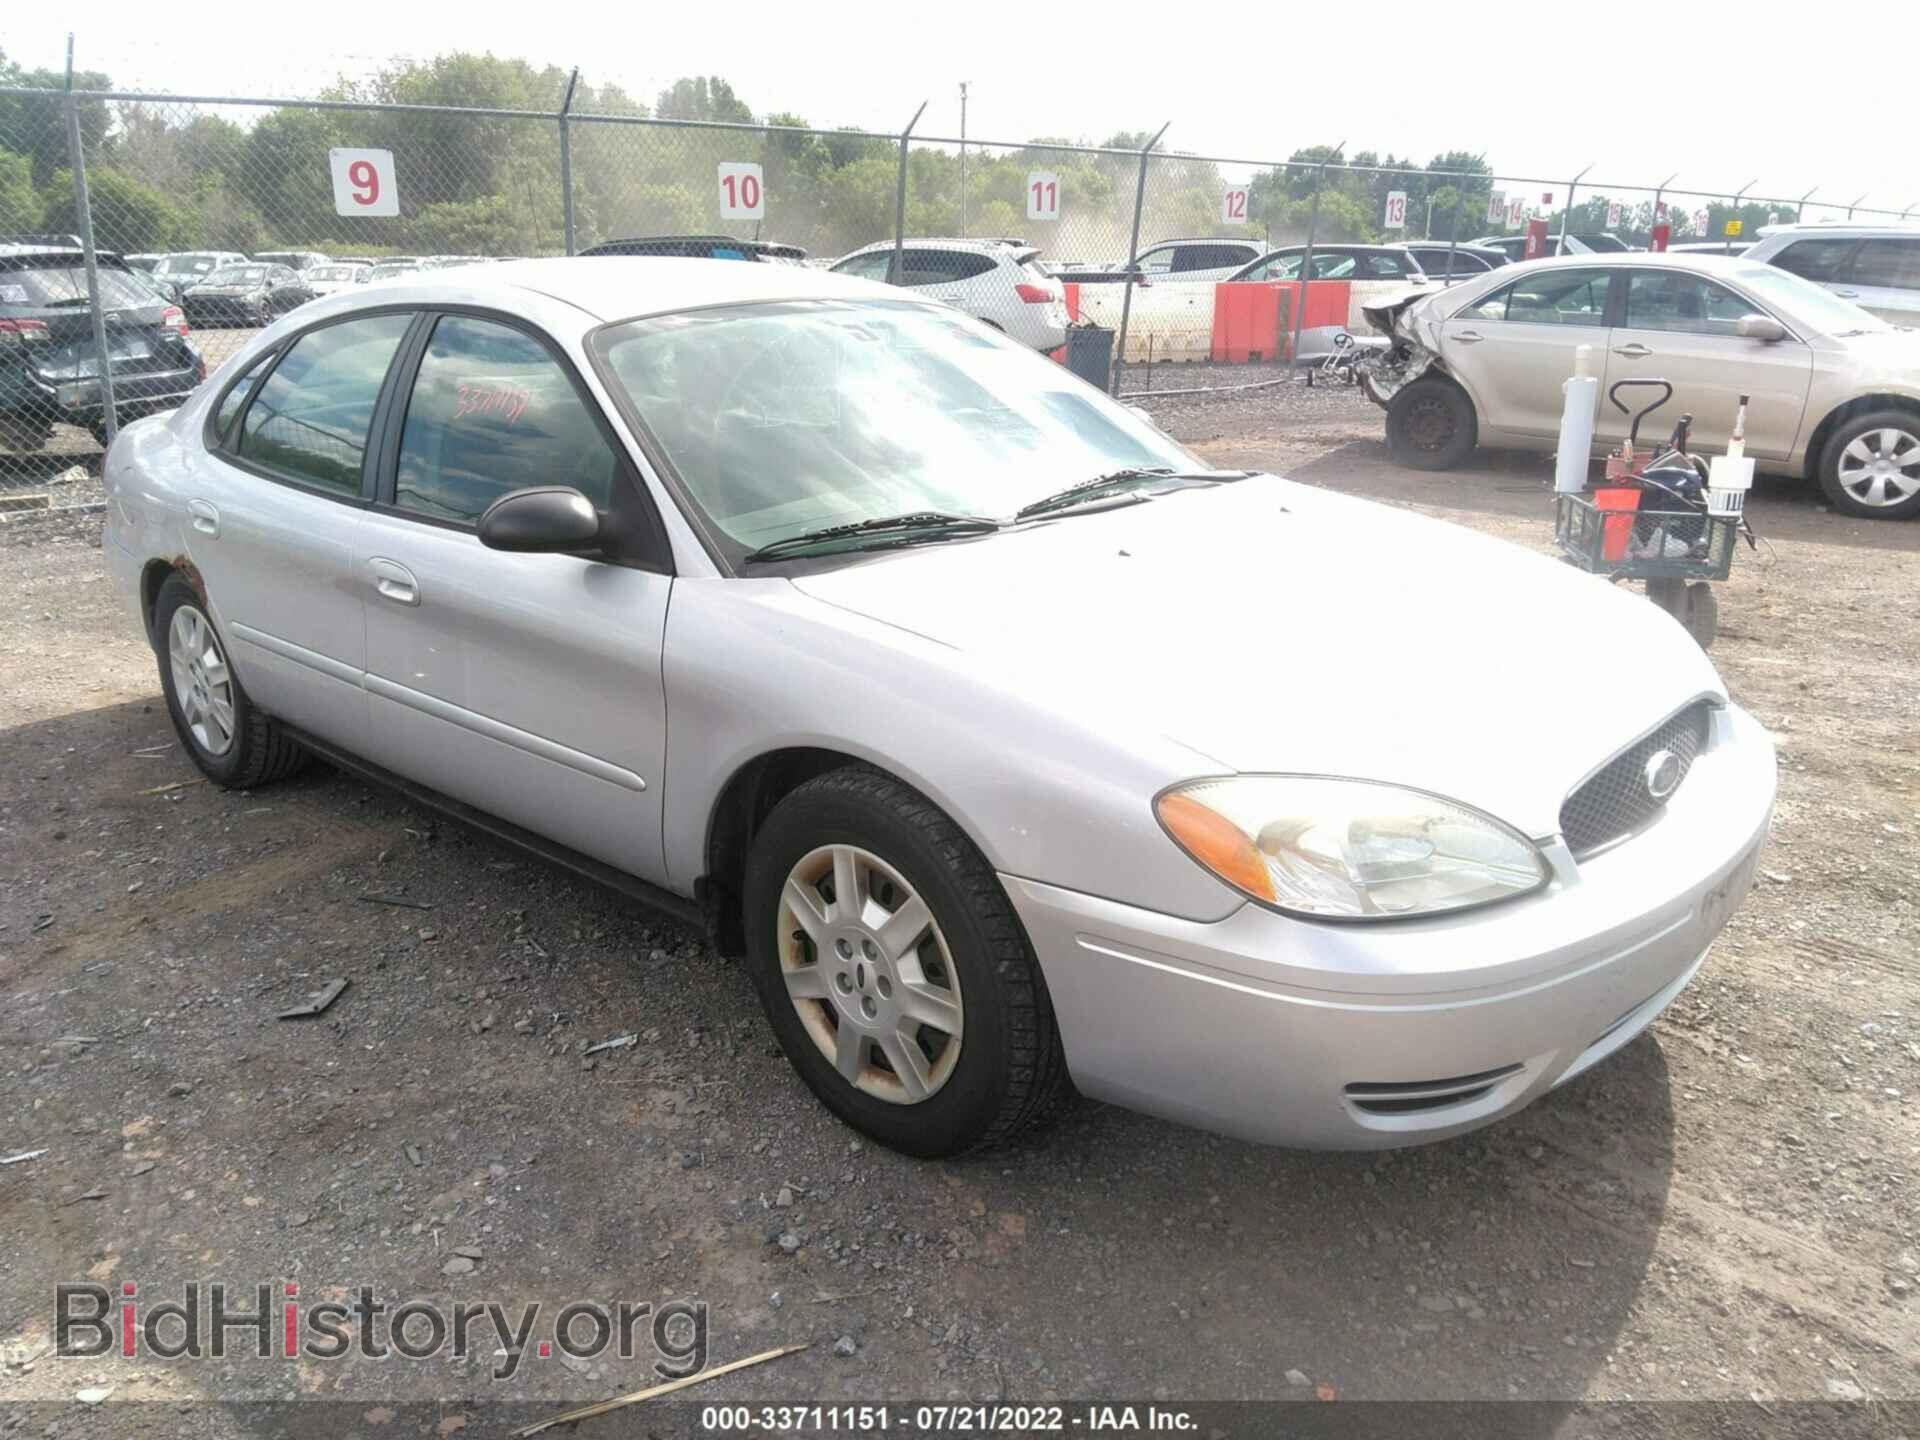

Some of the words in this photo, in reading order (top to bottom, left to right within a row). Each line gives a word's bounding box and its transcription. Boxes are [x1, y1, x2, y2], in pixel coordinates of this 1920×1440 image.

[349, 161, 380, 205] 9
[723, 175, 760, 209] 10
[1031, 181, 1056, 211] 11
[1225, 191, 1246, 218] 12
[1388, 198, 1404, 222] 13
